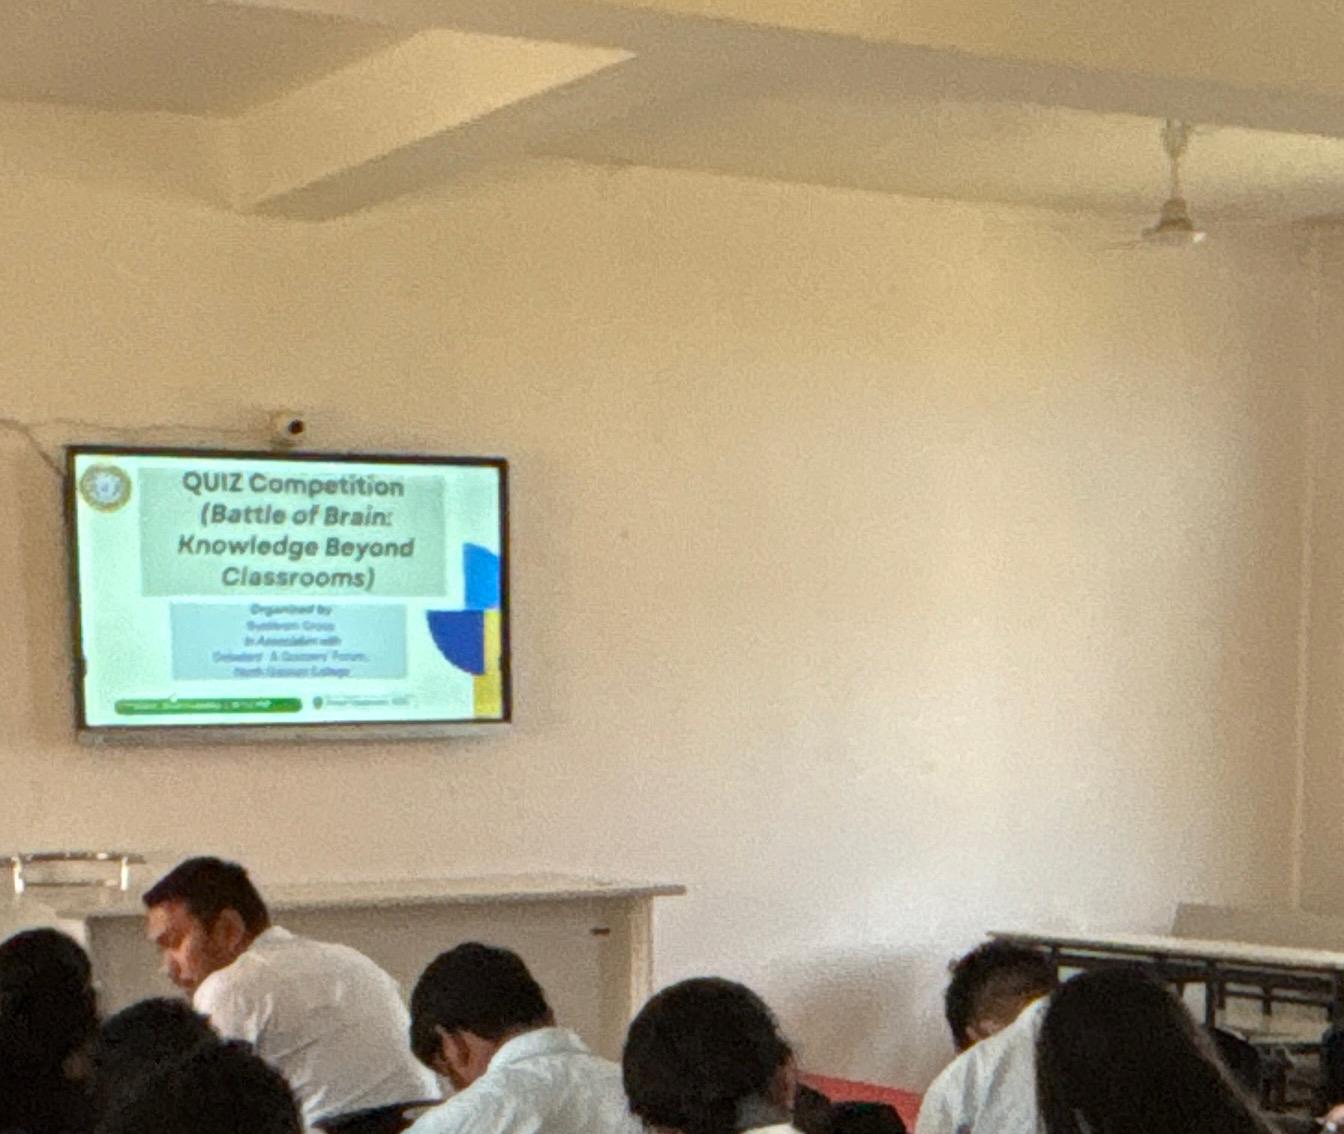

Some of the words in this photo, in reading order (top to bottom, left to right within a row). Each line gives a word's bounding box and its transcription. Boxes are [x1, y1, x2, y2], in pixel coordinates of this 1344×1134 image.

[182, 471, 244, 495] QUIZ
[249, 472, 404, 497] Competition
[201, 502, 287, 526] (Battle
[291, 504, 320, 525] of
[324, 505, 392, 526] Brain:
[177, 534, 319, 561] Knowledge
[325, 537, 415, 561] Beyond
[222, 566, 375, 591] Classrooms)
